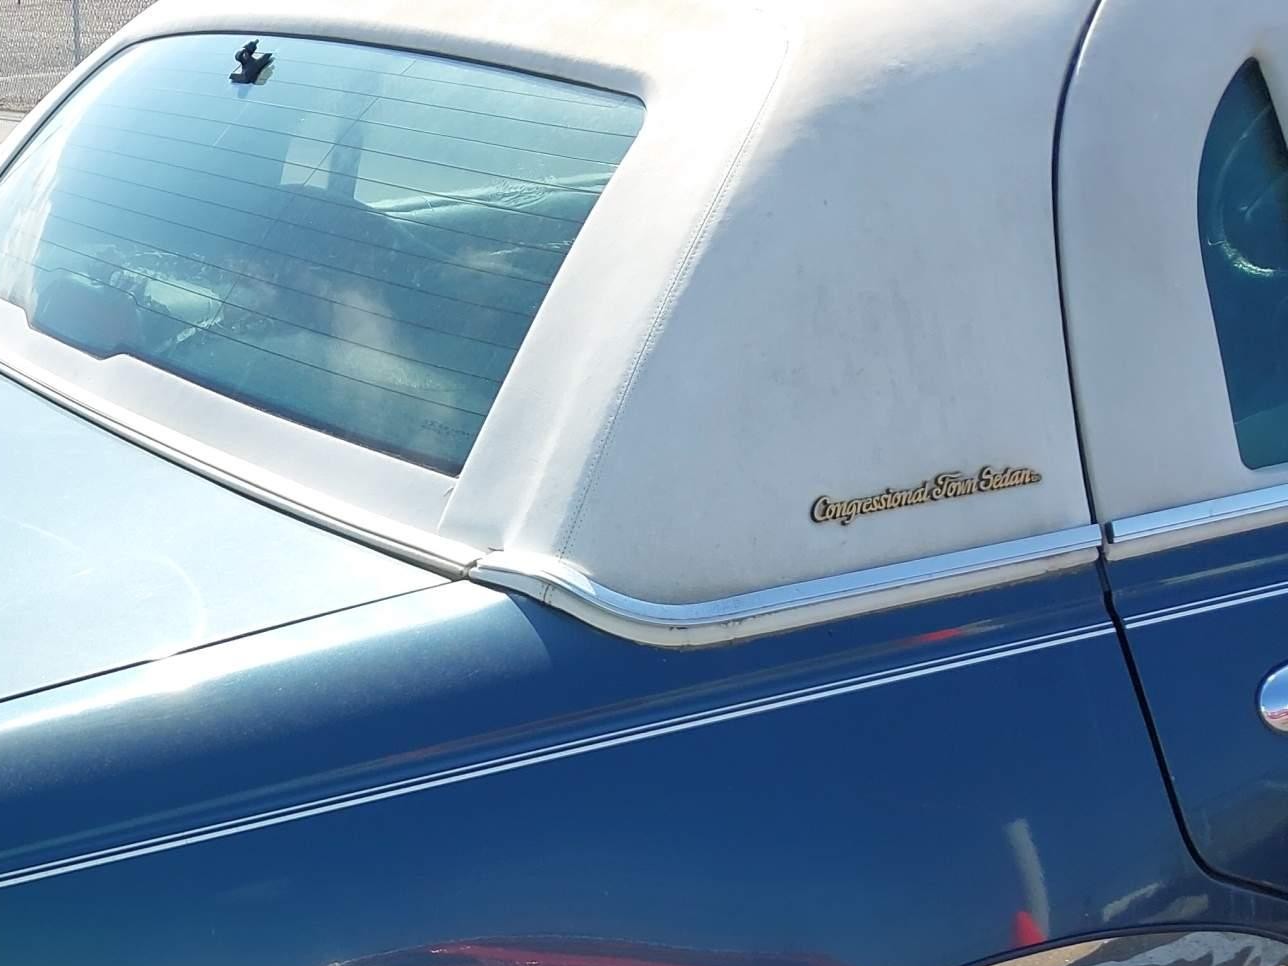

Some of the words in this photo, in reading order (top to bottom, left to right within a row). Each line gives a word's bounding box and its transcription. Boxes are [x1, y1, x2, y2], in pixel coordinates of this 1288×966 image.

[811, 480, 930, 526] Congressional
[930, 470, 978, 501] Town
[977, 465, 1037, 492] Sedan
